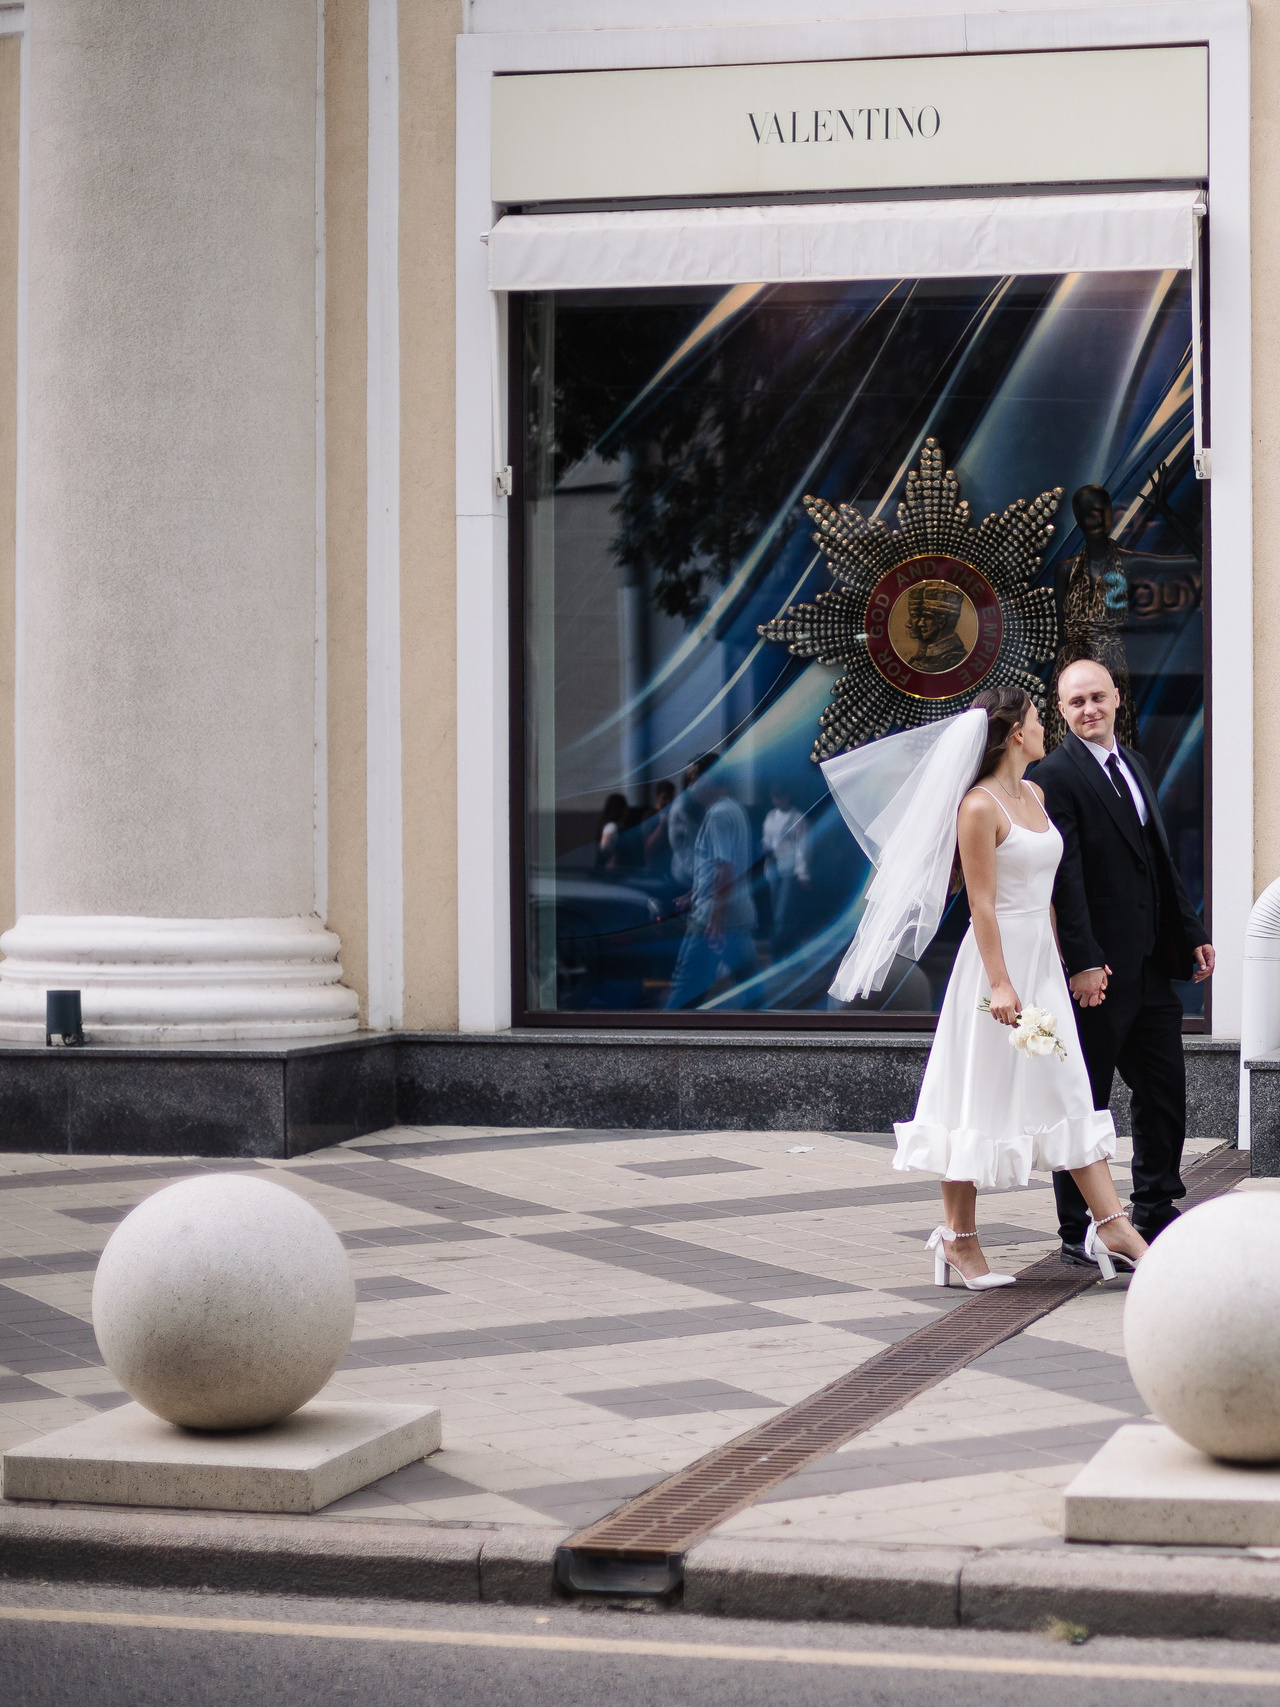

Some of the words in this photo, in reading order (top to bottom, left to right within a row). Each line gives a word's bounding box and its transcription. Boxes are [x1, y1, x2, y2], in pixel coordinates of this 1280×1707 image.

[745, 105, 941, 145] VALENTINO
[895, 561, 936, 587] AND
[951, 565, 986, 598] THE
[870, 593, 890, 638] GOD
[957, 605, 998, 685] EMPIRE
[877, 648, 911, 685] FOR
